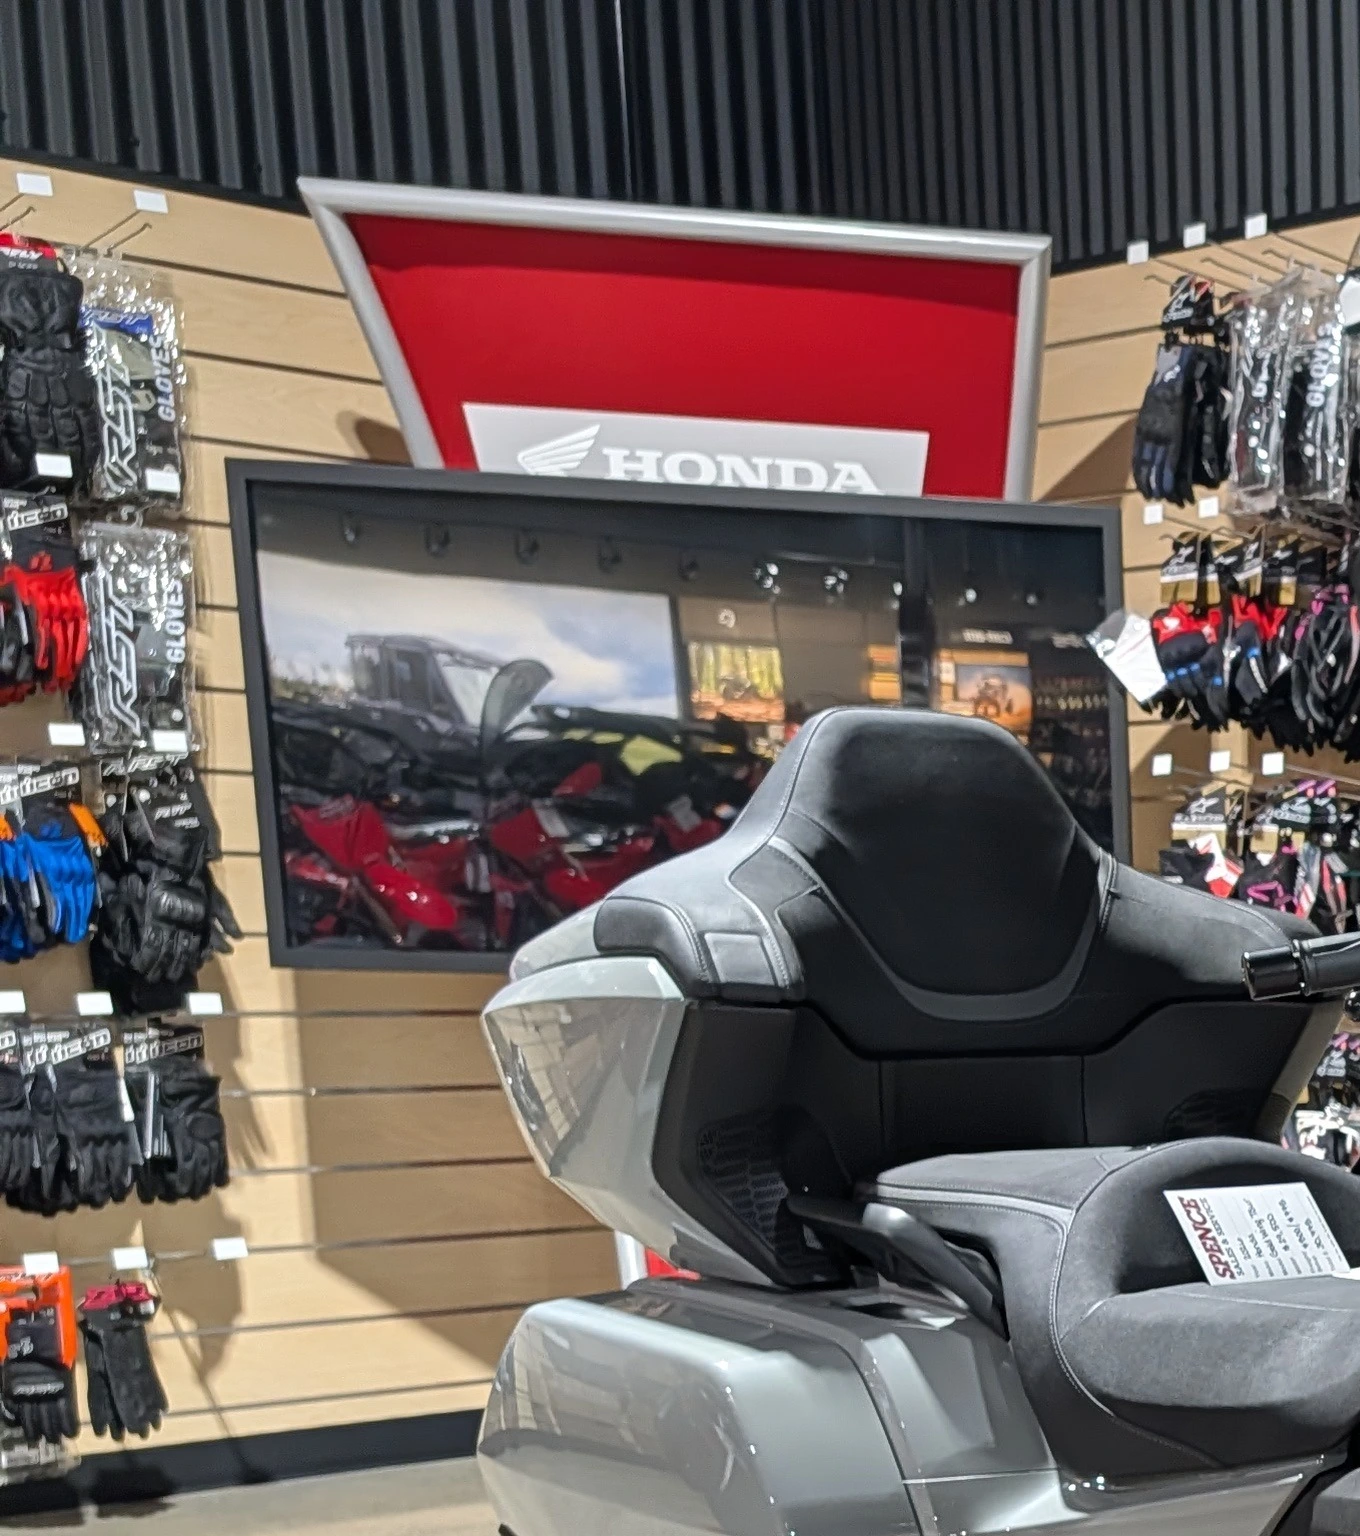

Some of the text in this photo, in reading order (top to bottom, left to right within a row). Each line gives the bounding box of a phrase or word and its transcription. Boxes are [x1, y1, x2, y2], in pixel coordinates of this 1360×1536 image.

[149, 336, 176, 423] GLOVES
[602, 447, 885, 495] HONDA
[163, 579, 187, 663] GLOVES
[1178, 1196, 1236, 1280] SPENCE
[1200, 1197, 1225, 1236] SERVICE
[1226, 1247, 1245, 1276] SALES
